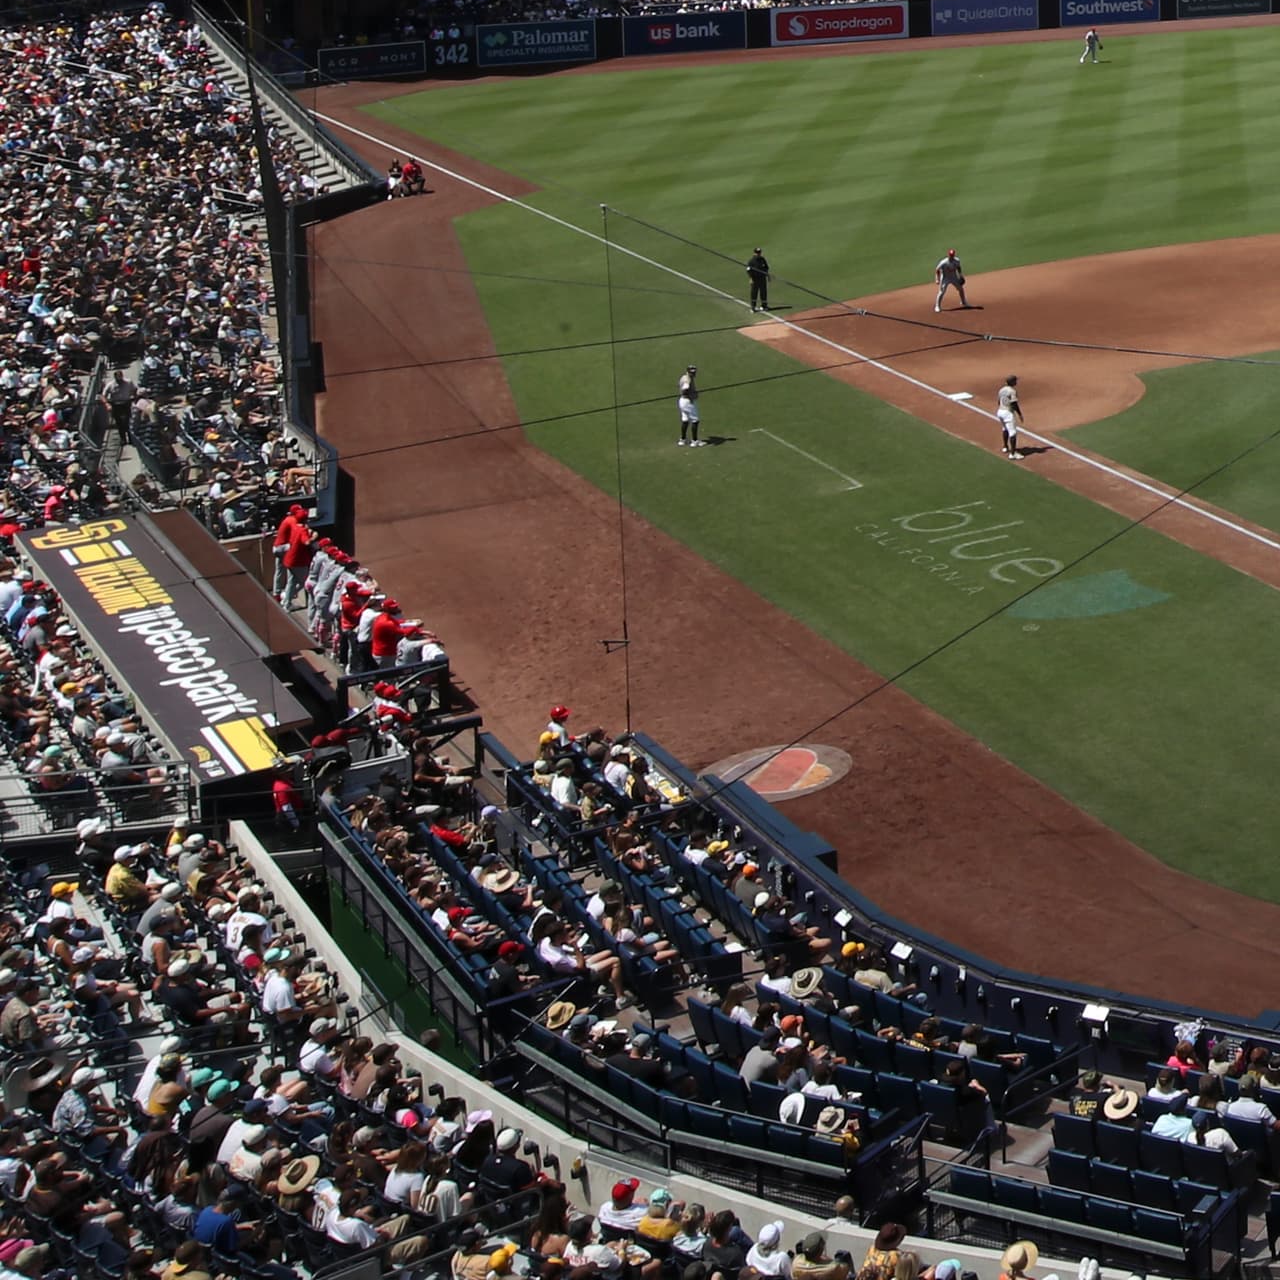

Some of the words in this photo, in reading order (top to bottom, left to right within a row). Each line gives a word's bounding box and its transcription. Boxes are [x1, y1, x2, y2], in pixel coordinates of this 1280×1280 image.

[957, 5, 1033, 22] QuidelOrtho
[650, 24, 670, 40] us
[676, 21, 720, 38] bank
[815, 14, 892, 32] Snapdragon
[512, 30, 589, 46] Palomar
[435, 44, 469, 64] 342
[891, 501, 1065, 583] blue
